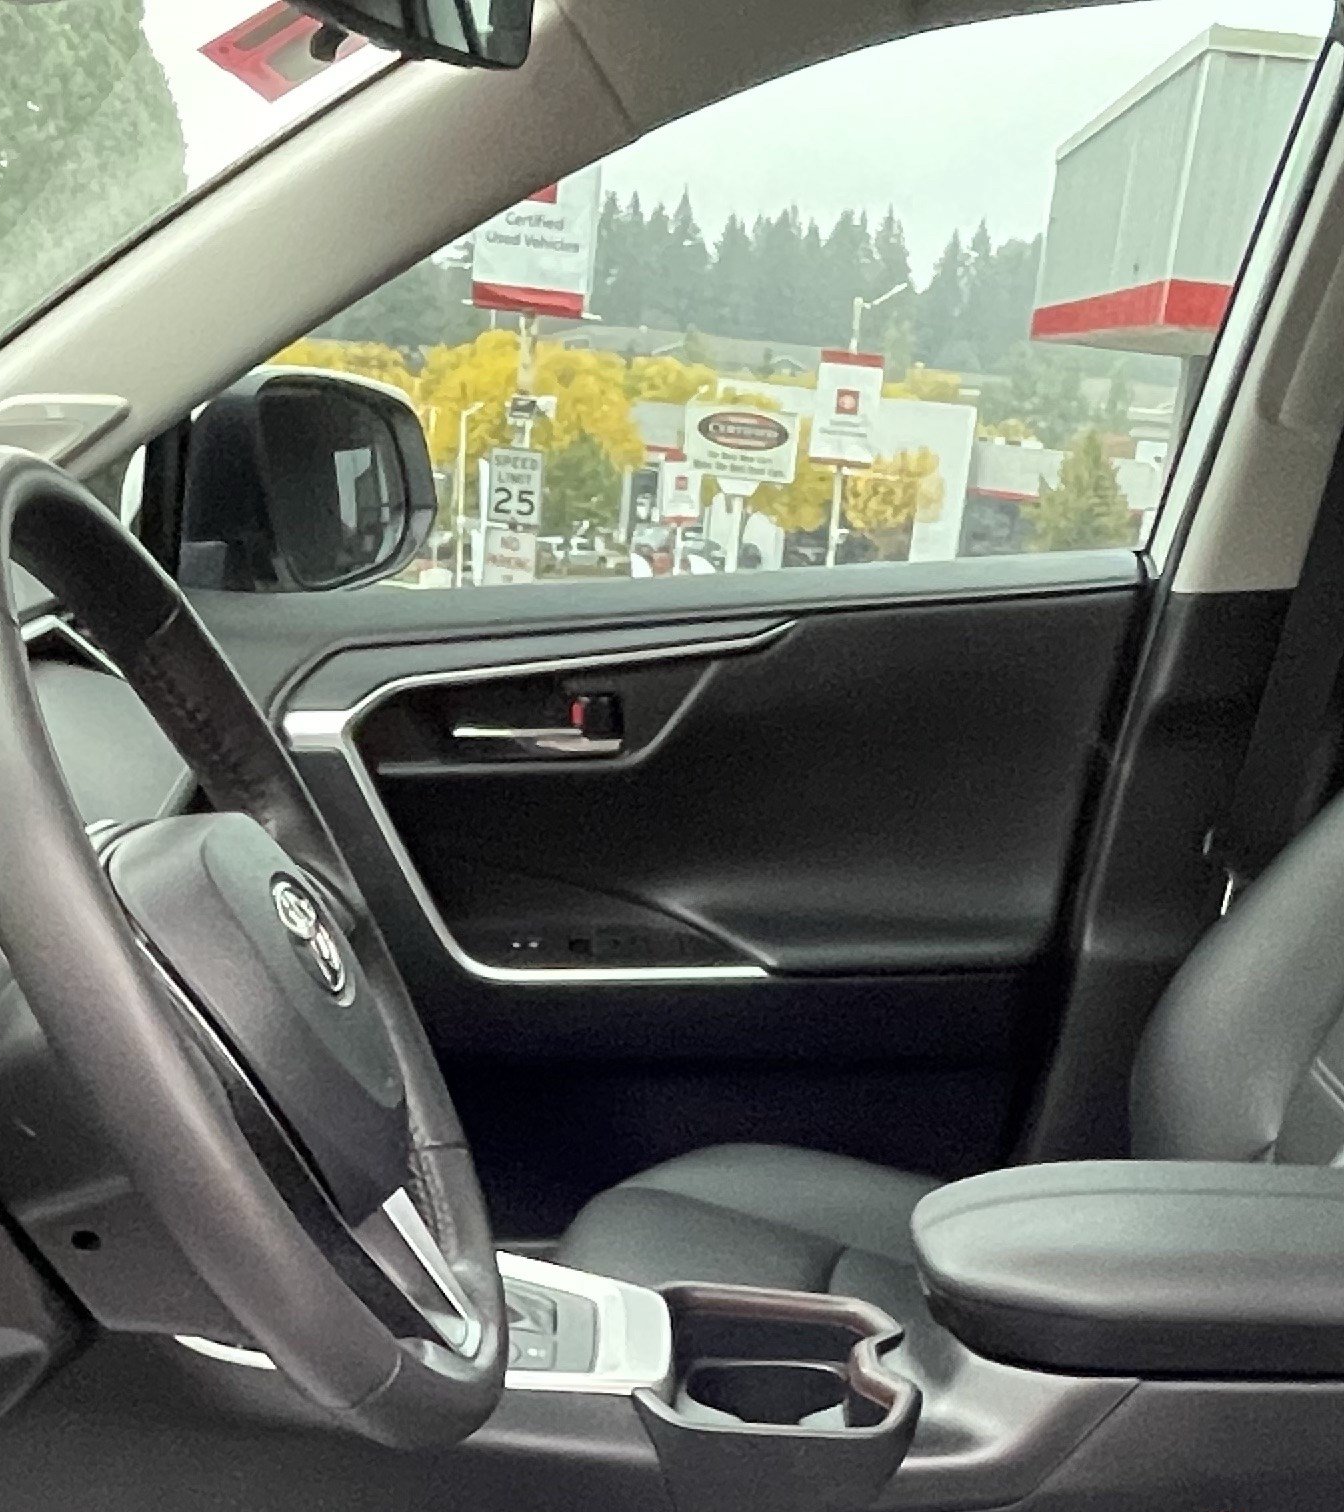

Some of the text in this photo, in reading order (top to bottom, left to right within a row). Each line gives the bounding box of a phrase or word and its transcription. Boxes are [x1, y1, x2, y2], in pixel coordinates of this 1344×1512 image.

[494, 454, 538, 472] SPEED
[497, 472, 532, 486] LIMIT
[493, 486, 536, 516] 25
